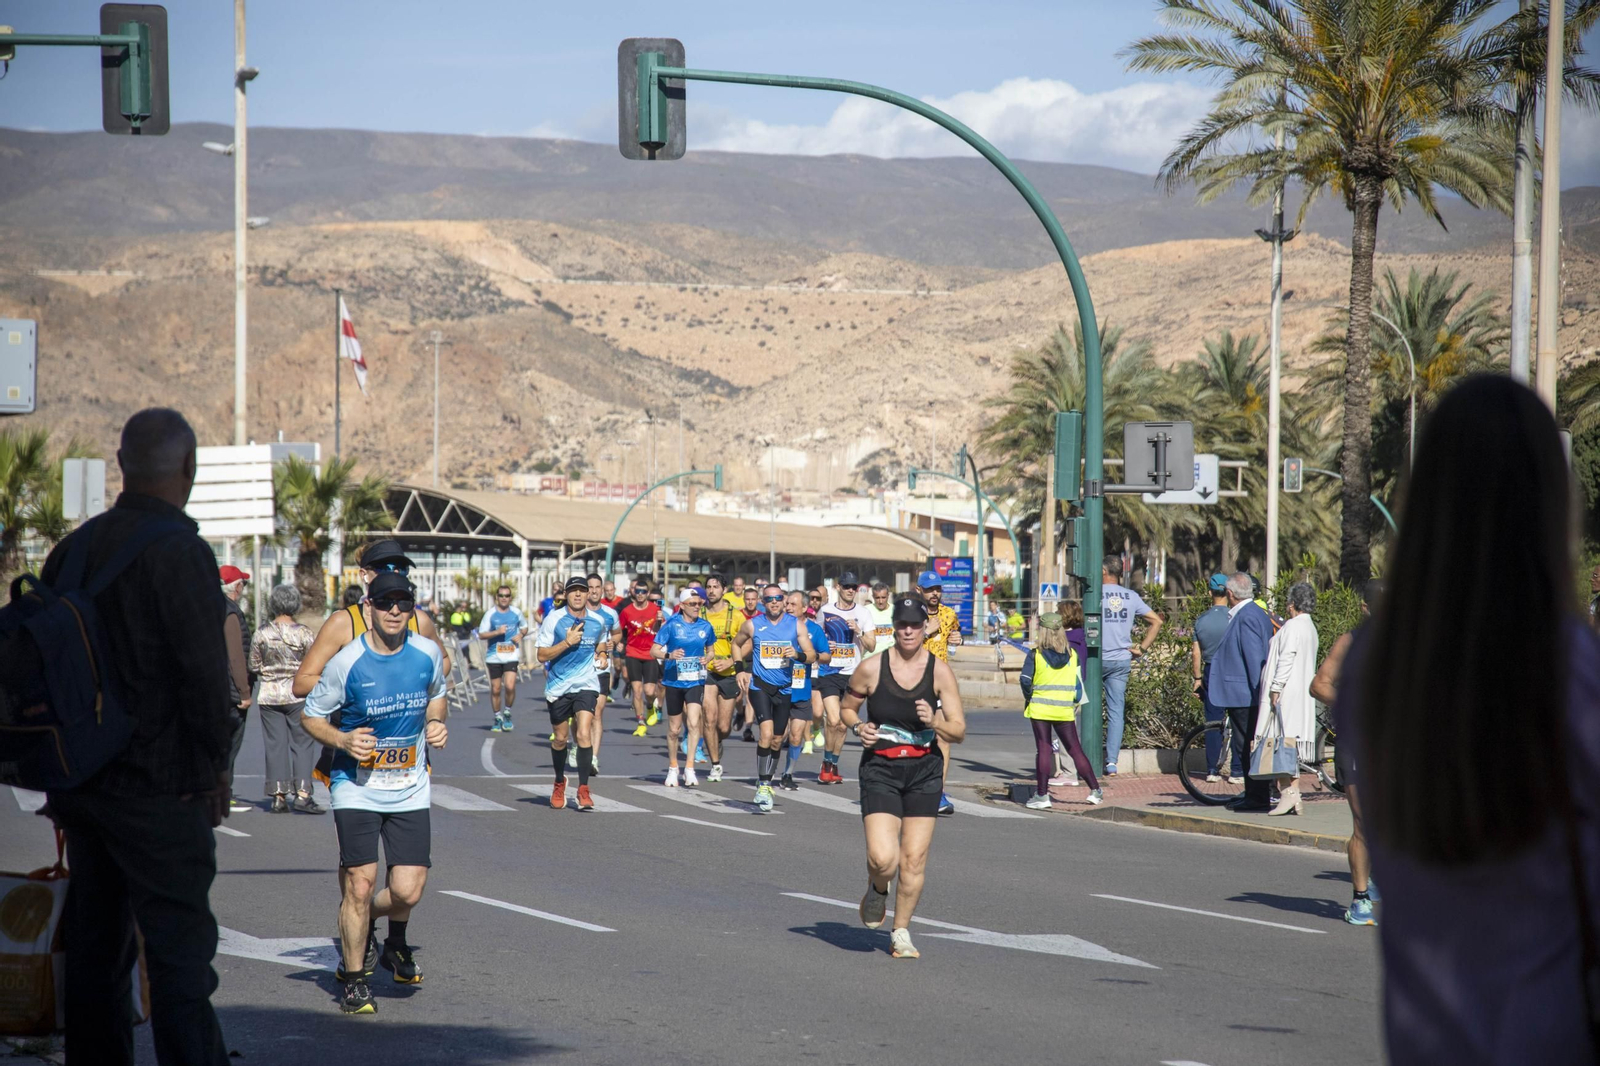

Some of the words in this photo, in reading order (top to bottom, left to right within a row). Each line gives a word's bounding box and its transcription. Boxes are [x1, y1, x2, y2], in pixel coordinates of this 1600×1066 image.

[1104, 608, 1128, 619] BIG
[765, 647, 783, 655] 130
[682, 662, 699, 670] 974
[365, 695, 394, 706] Medio
[366, 701, 405, 716] Almería
[374, 748, 409, 764] 786
